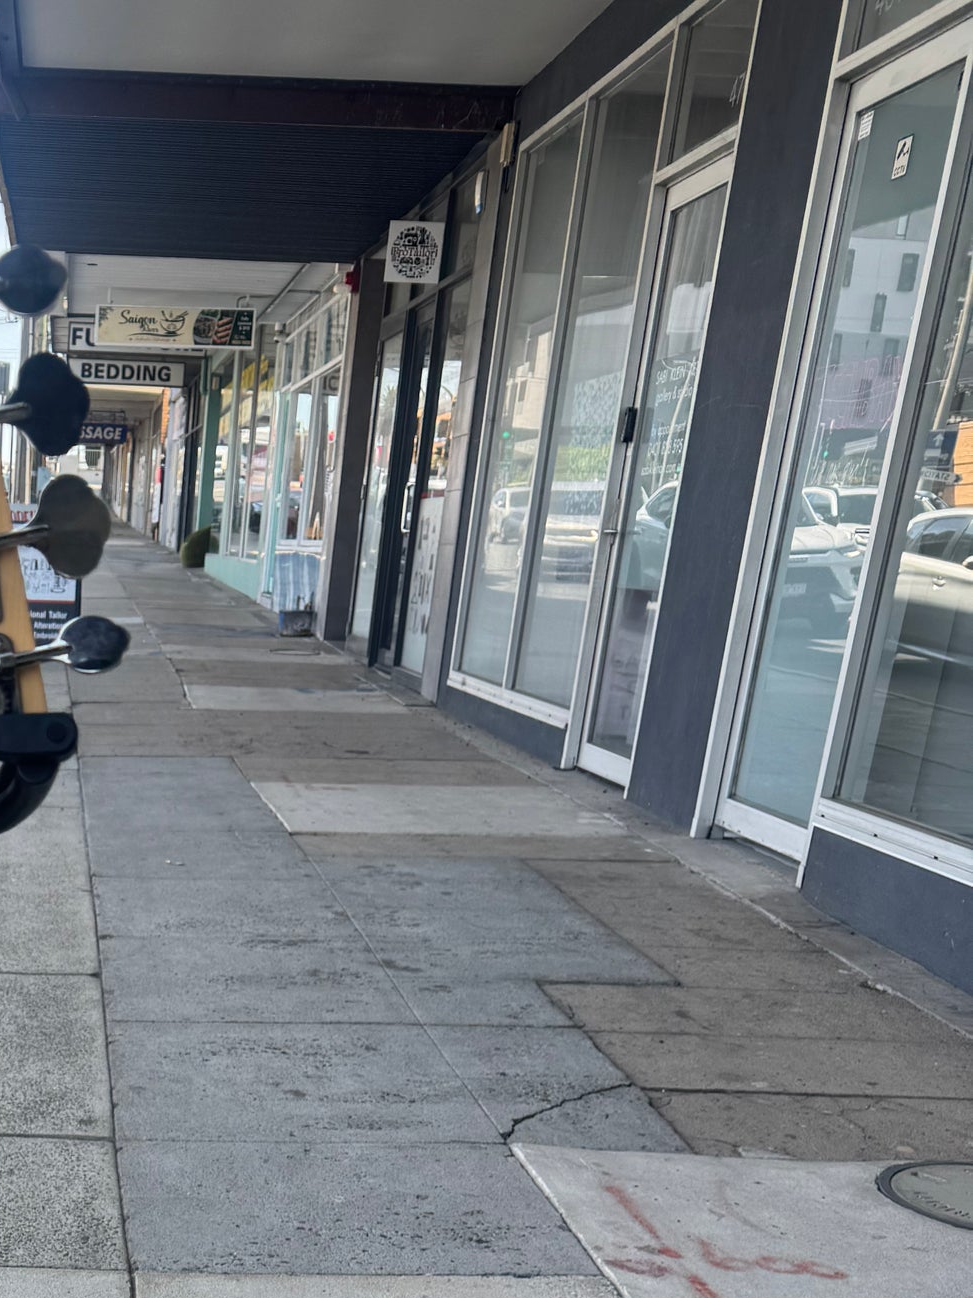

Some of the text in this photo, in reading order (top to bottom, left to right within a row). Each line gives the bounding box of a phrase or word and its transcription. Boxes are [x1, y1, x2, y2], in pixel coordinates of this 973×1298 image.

[118, 309, 158, 329] Saigon
[81, 362, 172, 382] BEDDING
[80, 425, 122, 440] SSAGE
[34, 621, 64, 630] Alteration
